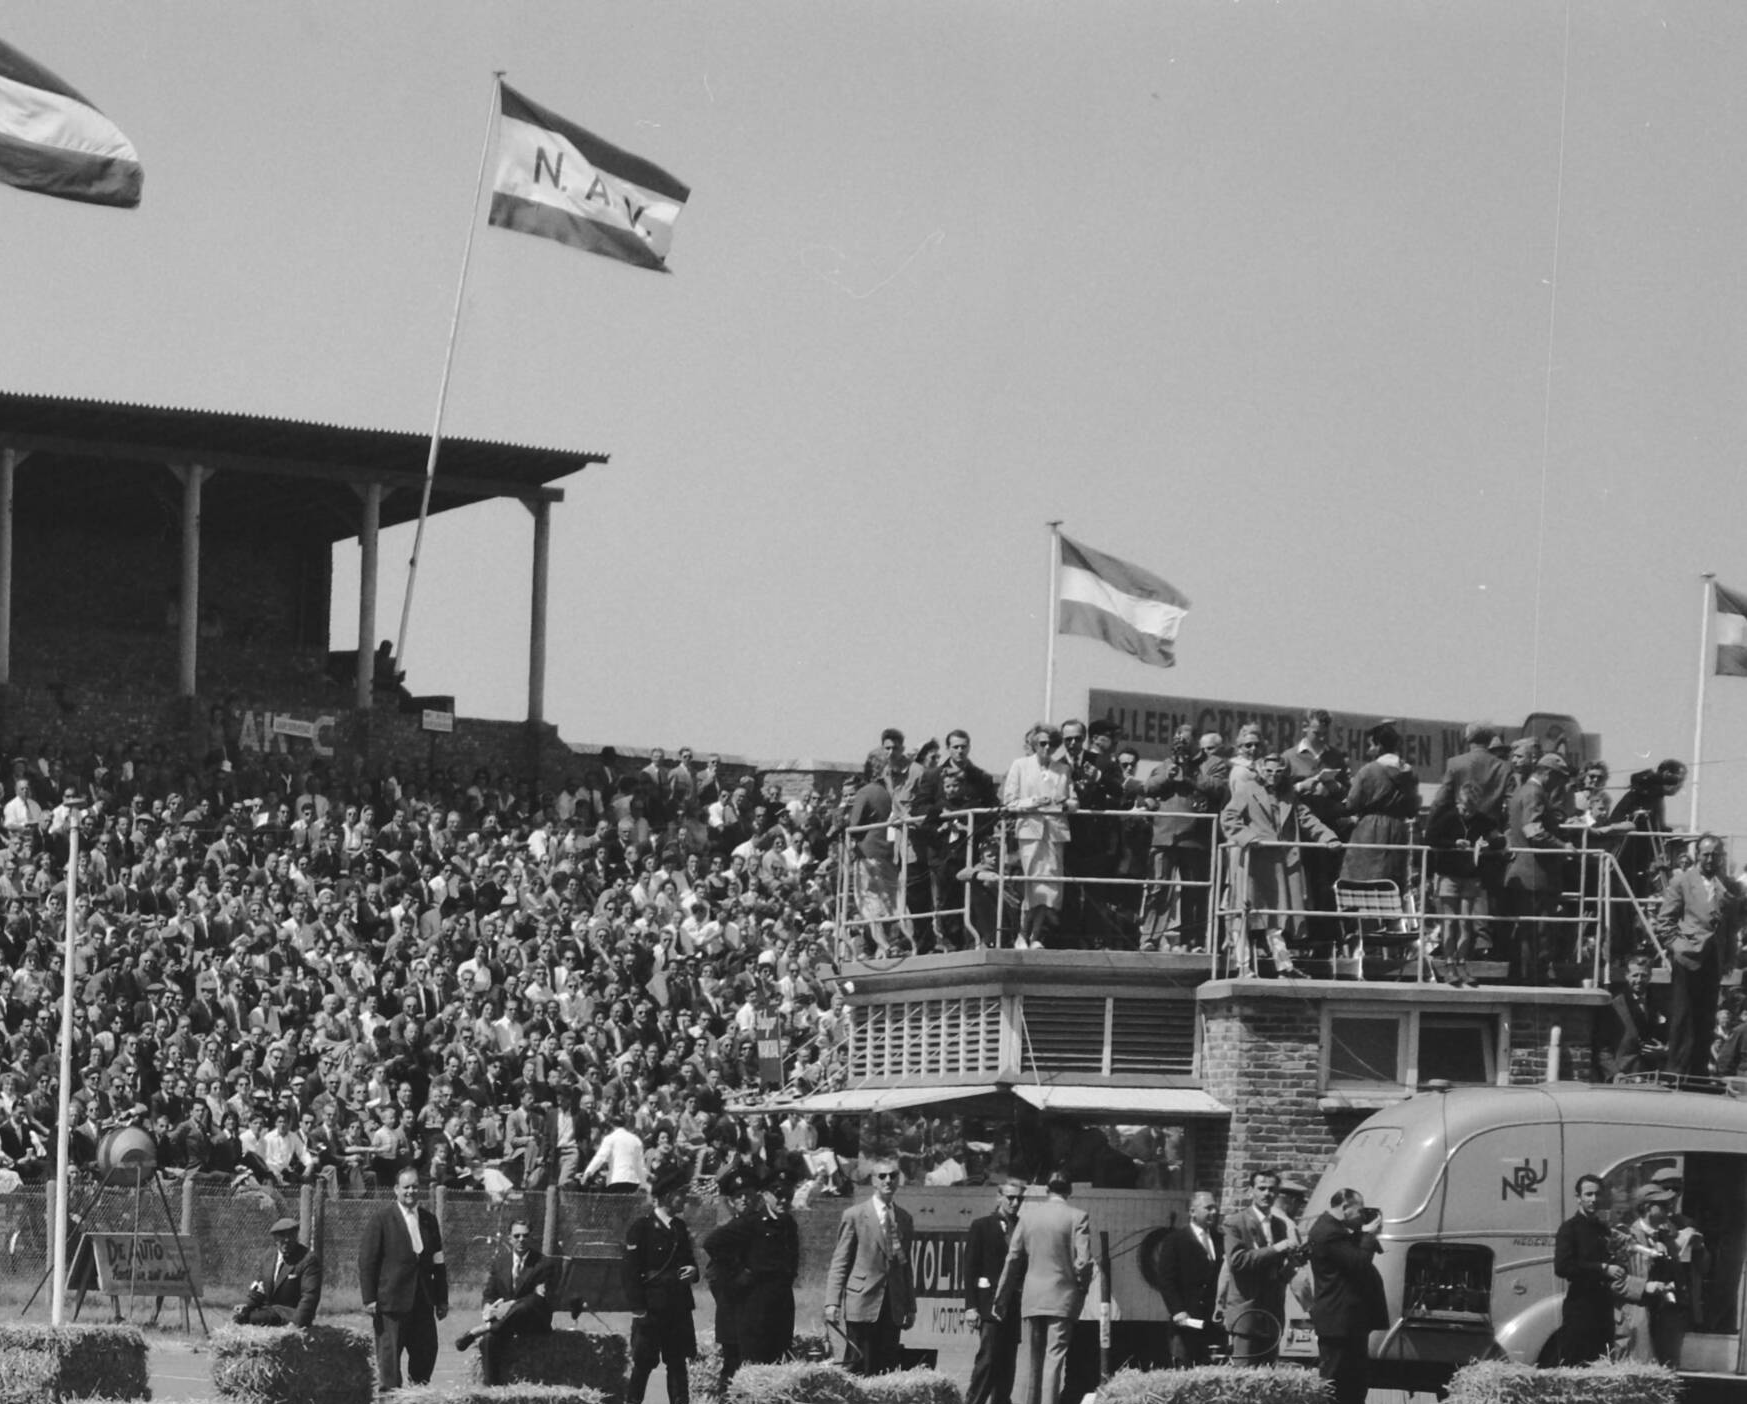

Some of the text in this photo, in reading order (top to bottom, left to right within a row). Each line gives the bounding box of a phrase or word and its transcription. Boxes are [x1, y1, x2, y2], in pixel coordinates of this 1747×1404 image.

[238, 710, 291, 753] AK
[311, 714, 336, 757] C
[1348, 727, 1432, 767] HEEN
[127, 1238, 164, 1266] AUTO
[910, 1239, 967, 1291] VOLI
